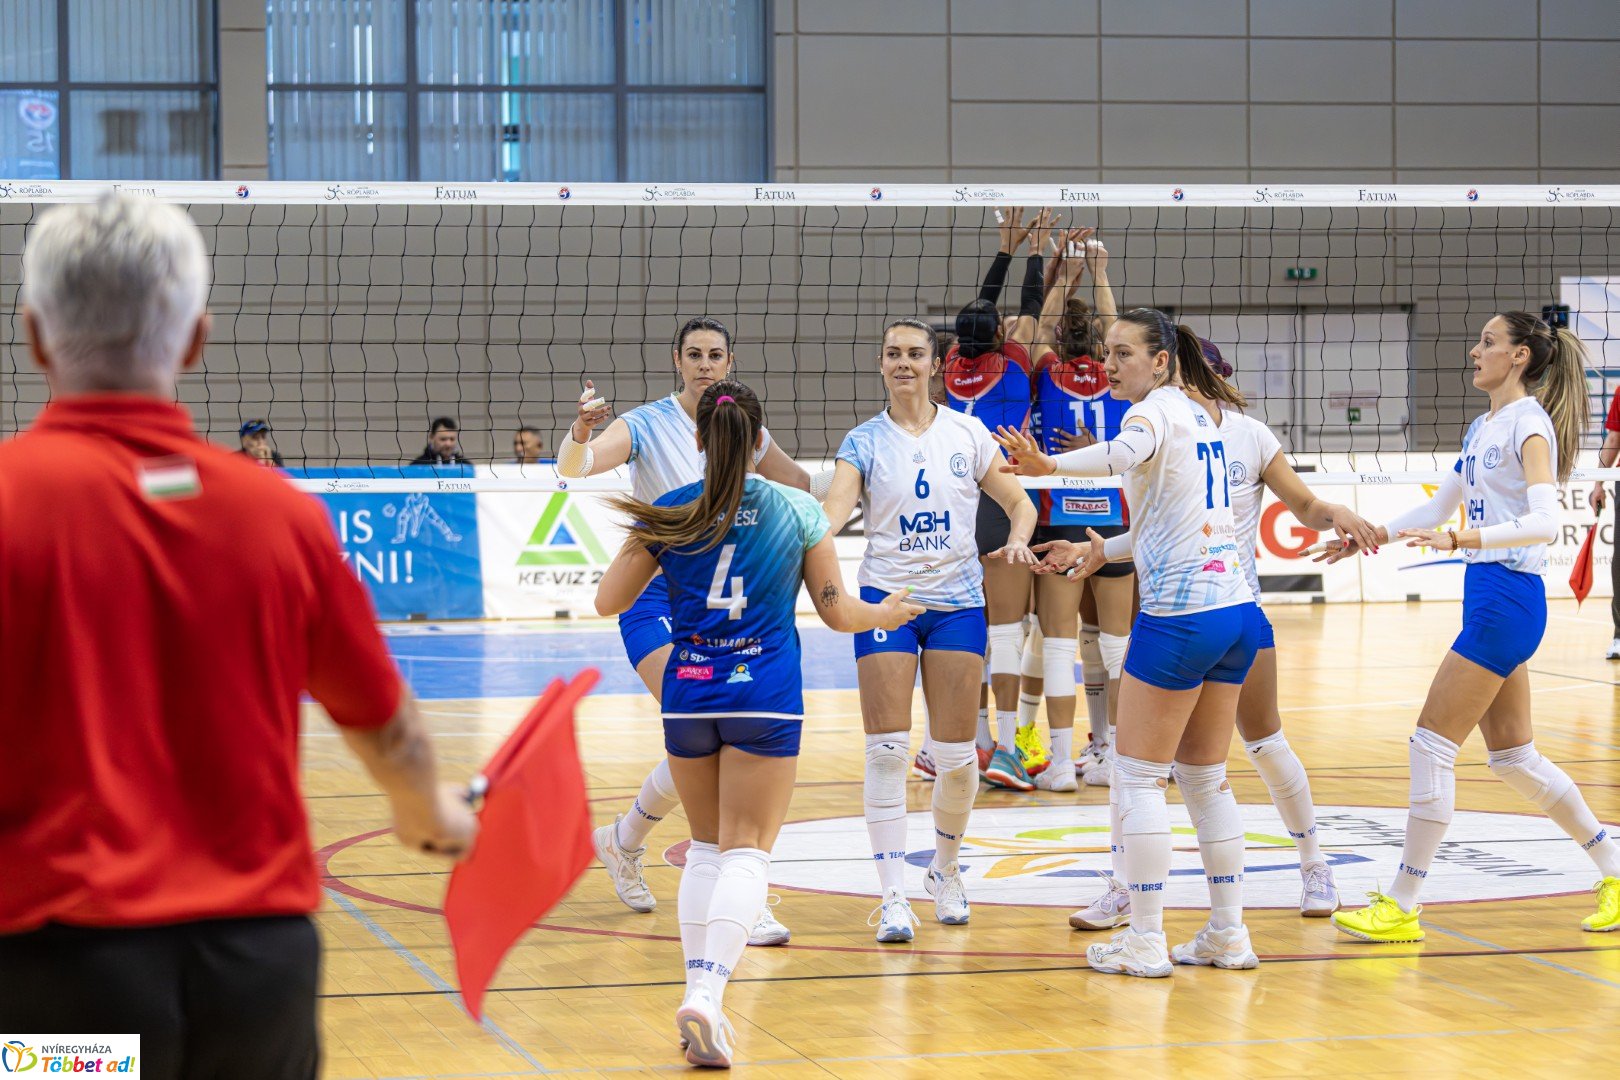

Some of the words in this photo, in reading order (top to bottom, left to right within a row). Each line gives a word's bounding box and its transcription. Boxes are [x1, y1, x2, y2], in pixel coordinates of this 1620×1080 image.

[435, 186, 477, 200] FATUM
[754, 187, 796, 200] FATUM
[1060, 188, 1100, 201] FATUM
[1358, 189, 1398, 201] FATUM
[1069, 400, 1106, 443] 11
[1196, 440, 1229, 509] 77
[1465, 455, 1476, 487] 10
[914, 468, 930, 500] 6
[1061, 477, 1095, 487] FATUM
[1065, 502, 1108, 511] STRABAG
[339, 509, 374, 544] IS
[900, 510, 950, 536] MBH
[899, 534, 951, 552] BANK
[518, 571, 586, 585] KE-VIZ
[707, 544, 748, 620] 4
[873, 627, 888, 643] 6
[1141, 882, 1163, 892] BRSE
[1213, 875, 1235, 884] BRSE
